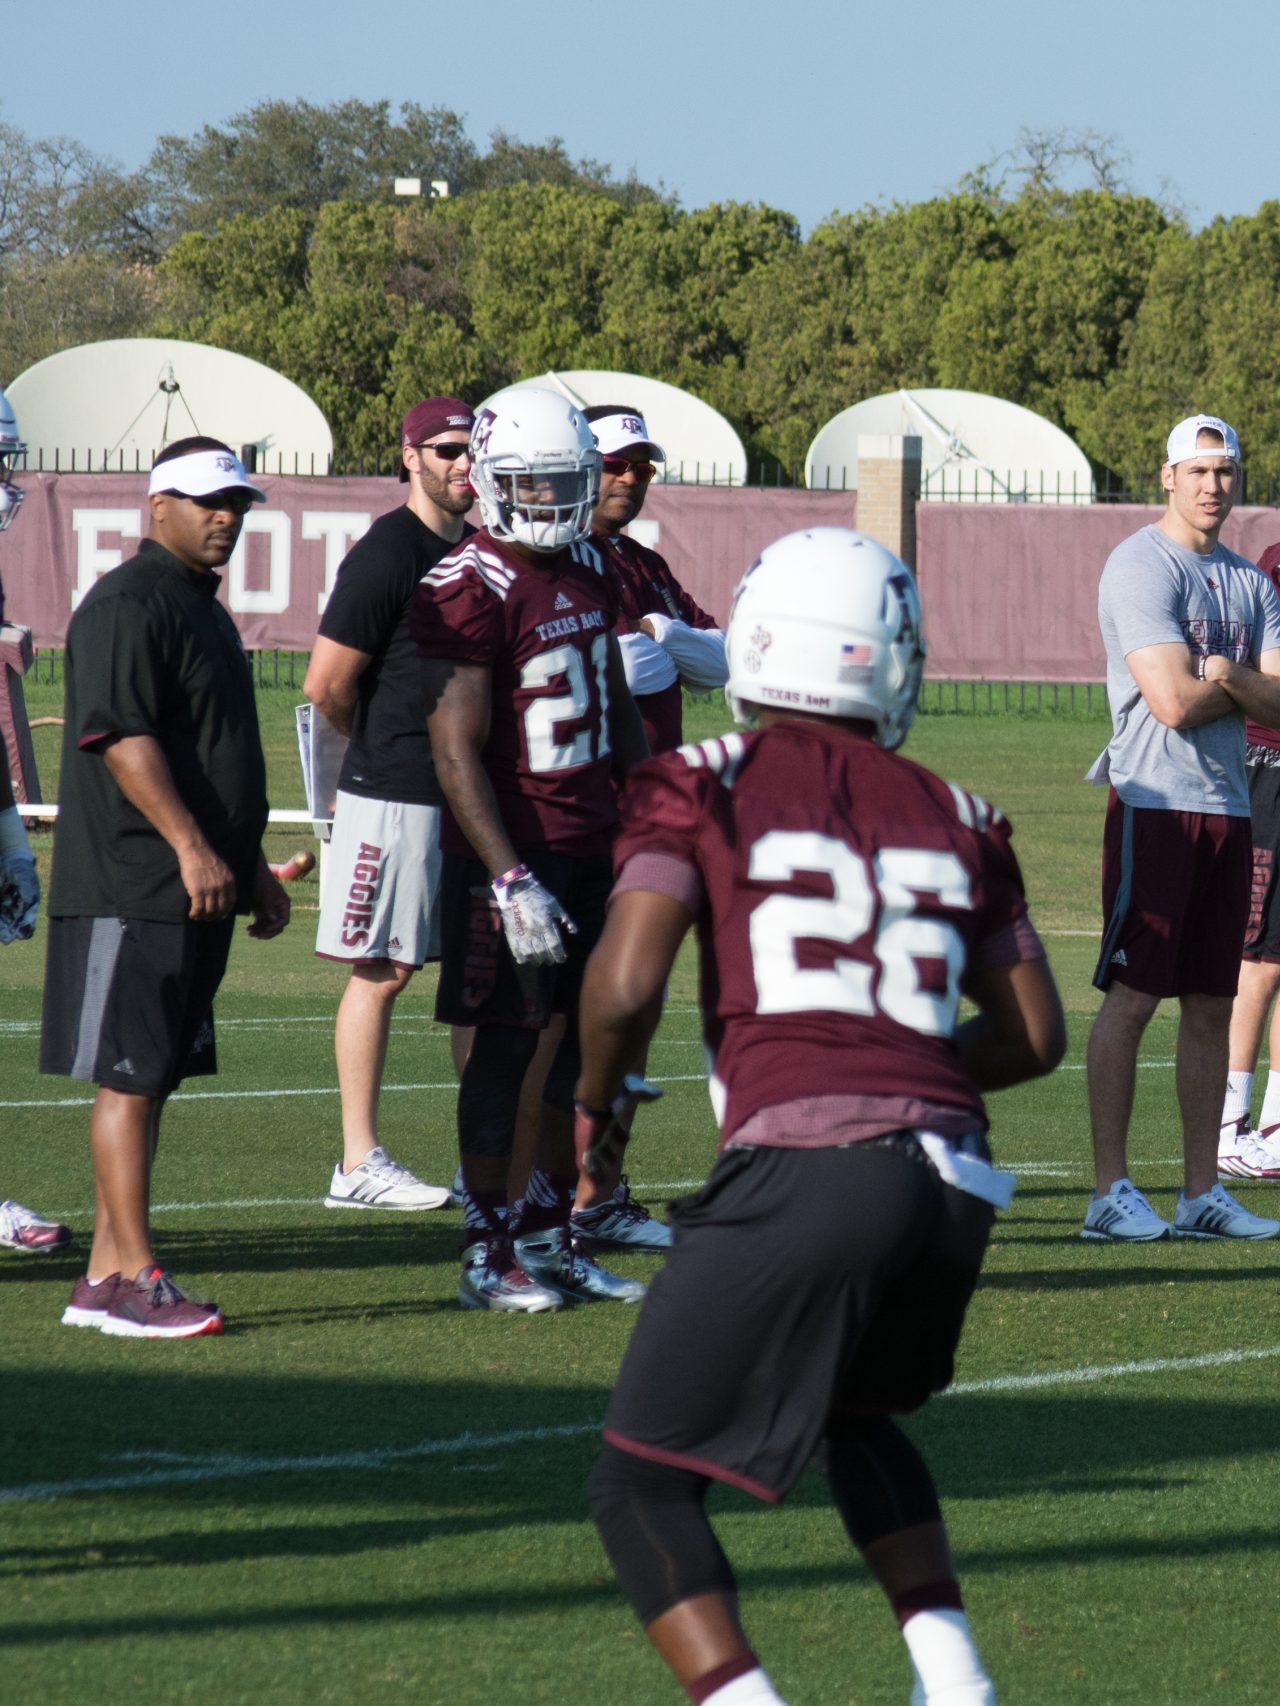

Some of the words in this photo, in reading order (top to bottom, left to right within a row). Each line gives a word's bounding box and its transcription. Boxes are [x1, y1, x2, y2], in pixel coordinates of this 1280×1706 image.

[535, 615, 579, 641] TEXAS
[579, 610, 605, 631] A&M
[520, 632, 612, 773] 21
[760, 686, 801, 704] TEXAS
[340, 841, 383, 948] AGGIES
[512, 899, 525, 938] adizero
[748, 829, 975, 1038] 26
